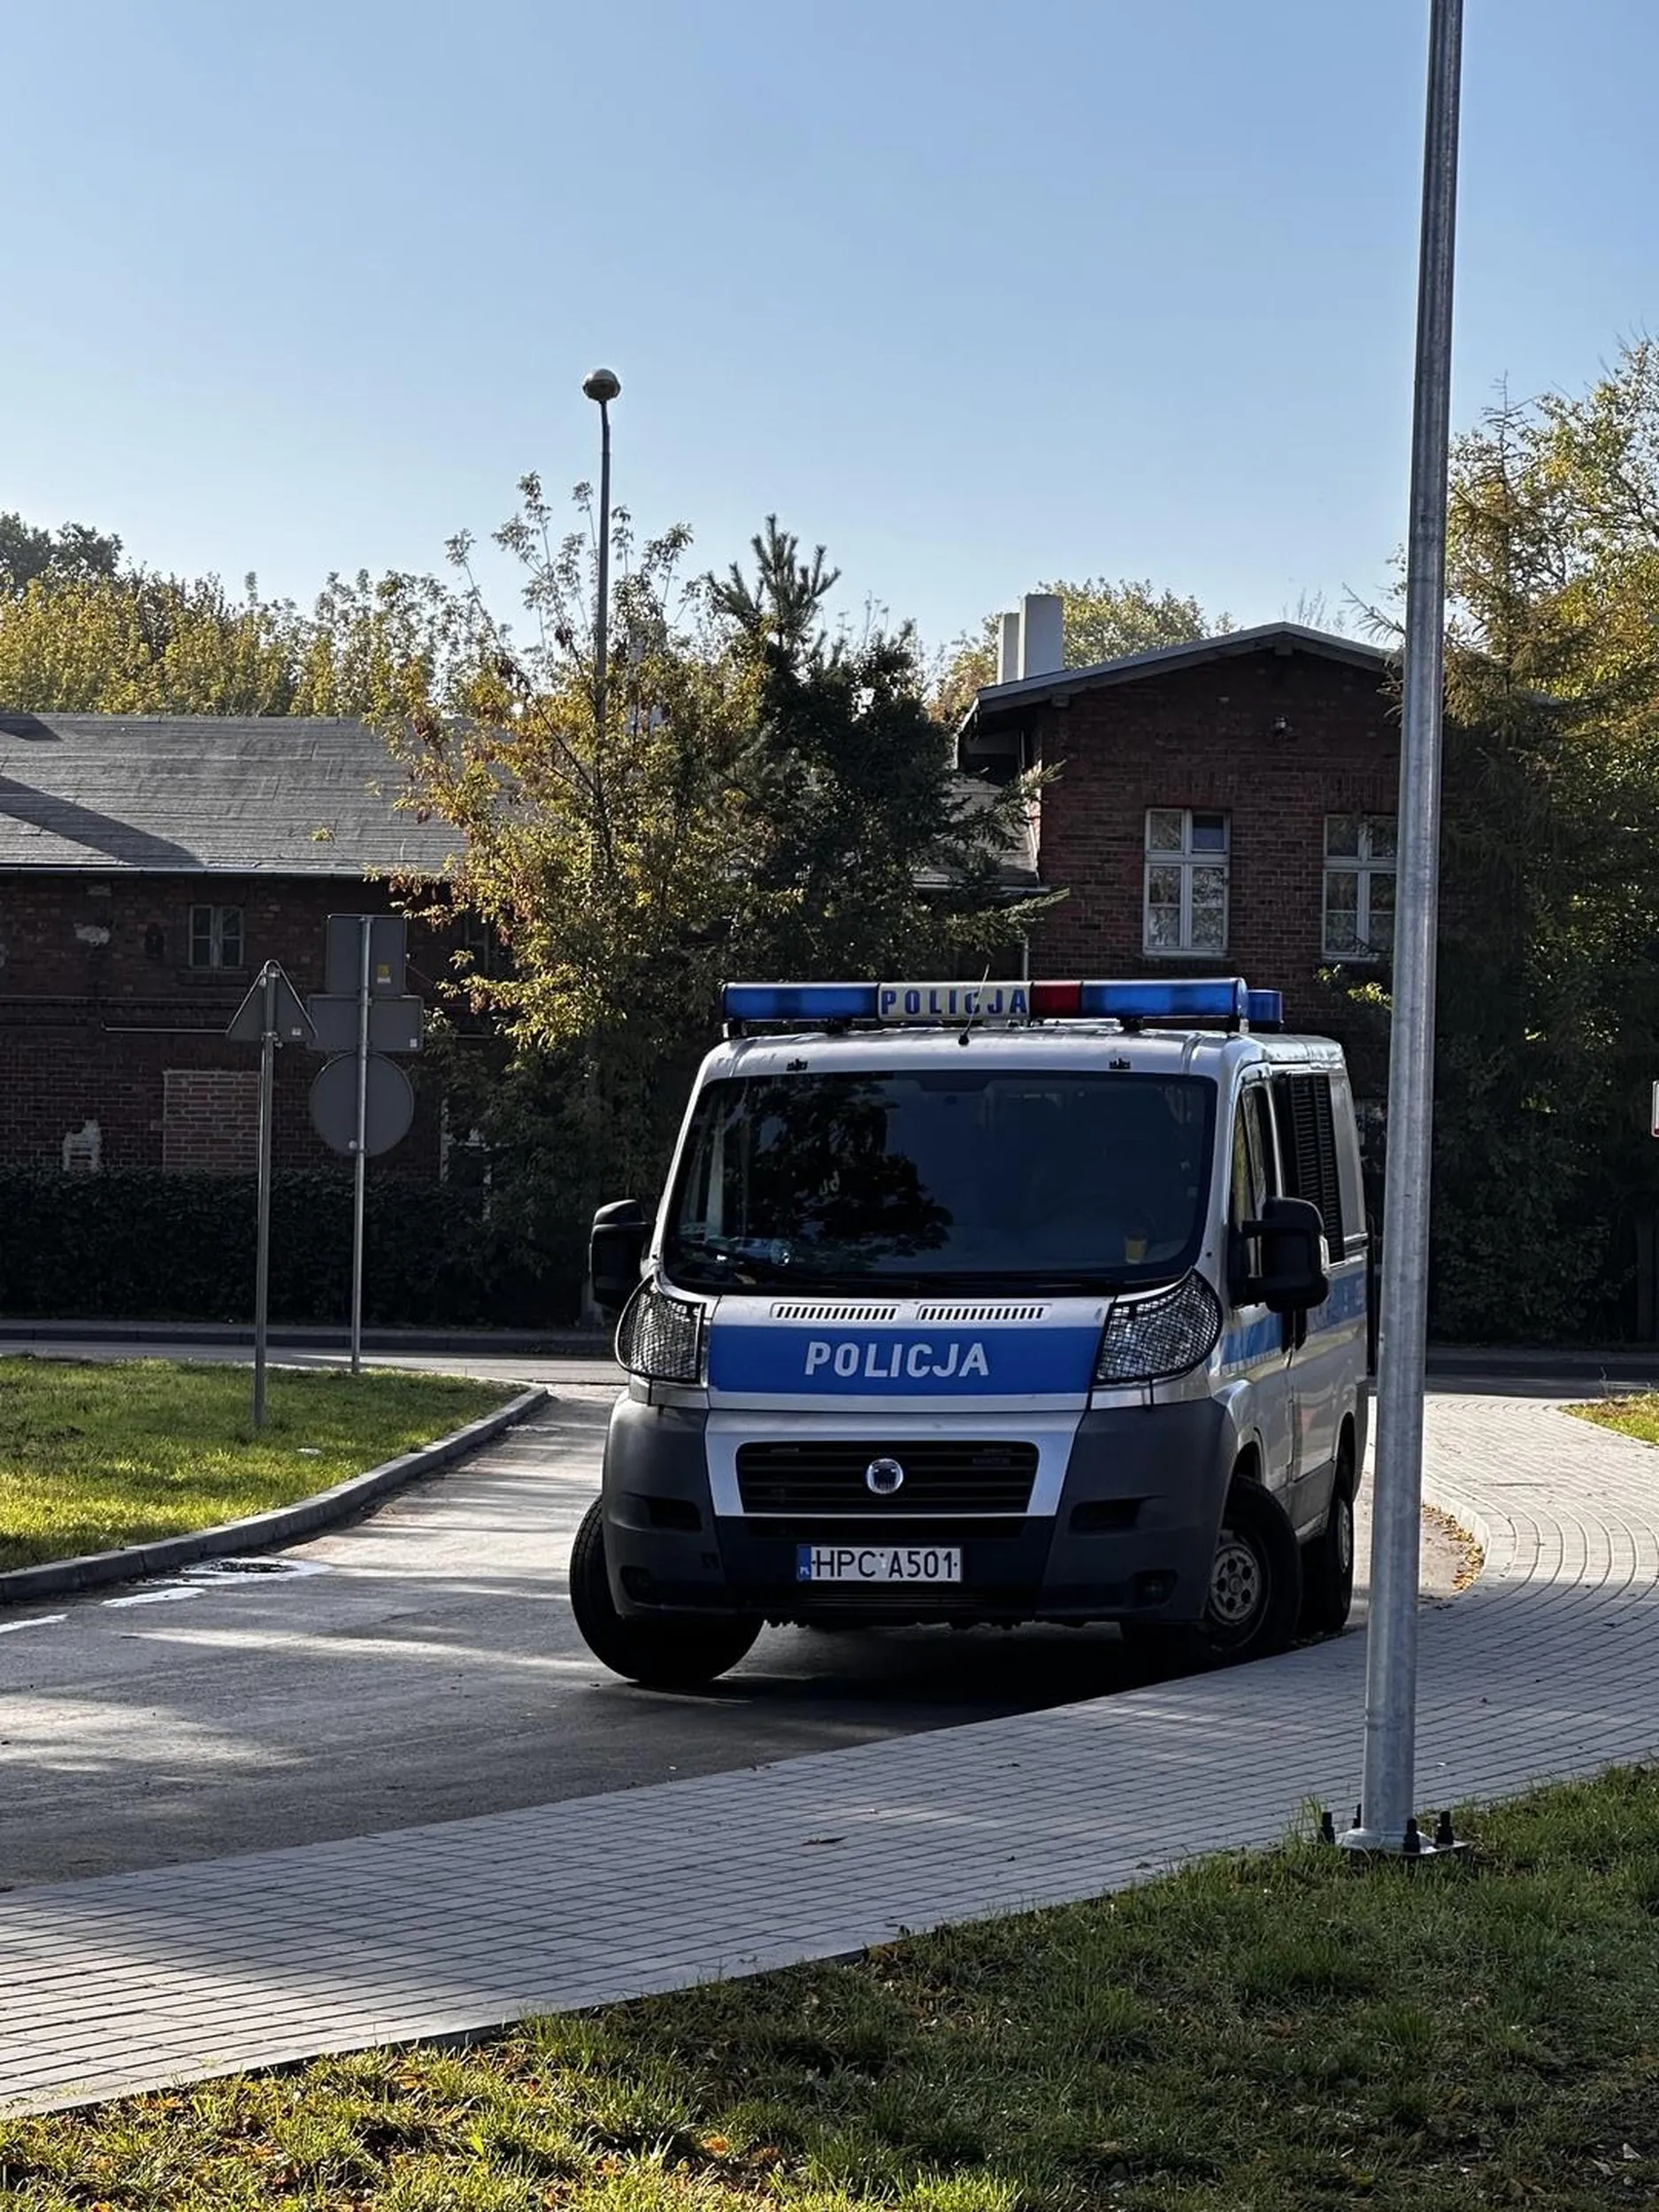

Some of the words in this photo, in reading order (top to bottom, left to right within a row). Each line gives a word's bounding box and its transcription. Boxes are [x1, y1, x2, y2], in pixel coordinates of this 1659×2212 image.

[880, 989, 1027, 1015] POLICJA
[804, 1341, 990, 1378] POLICJA
[816, 1550, 876, 1578] HPC
[888, 1550, 952, 1579] A501
